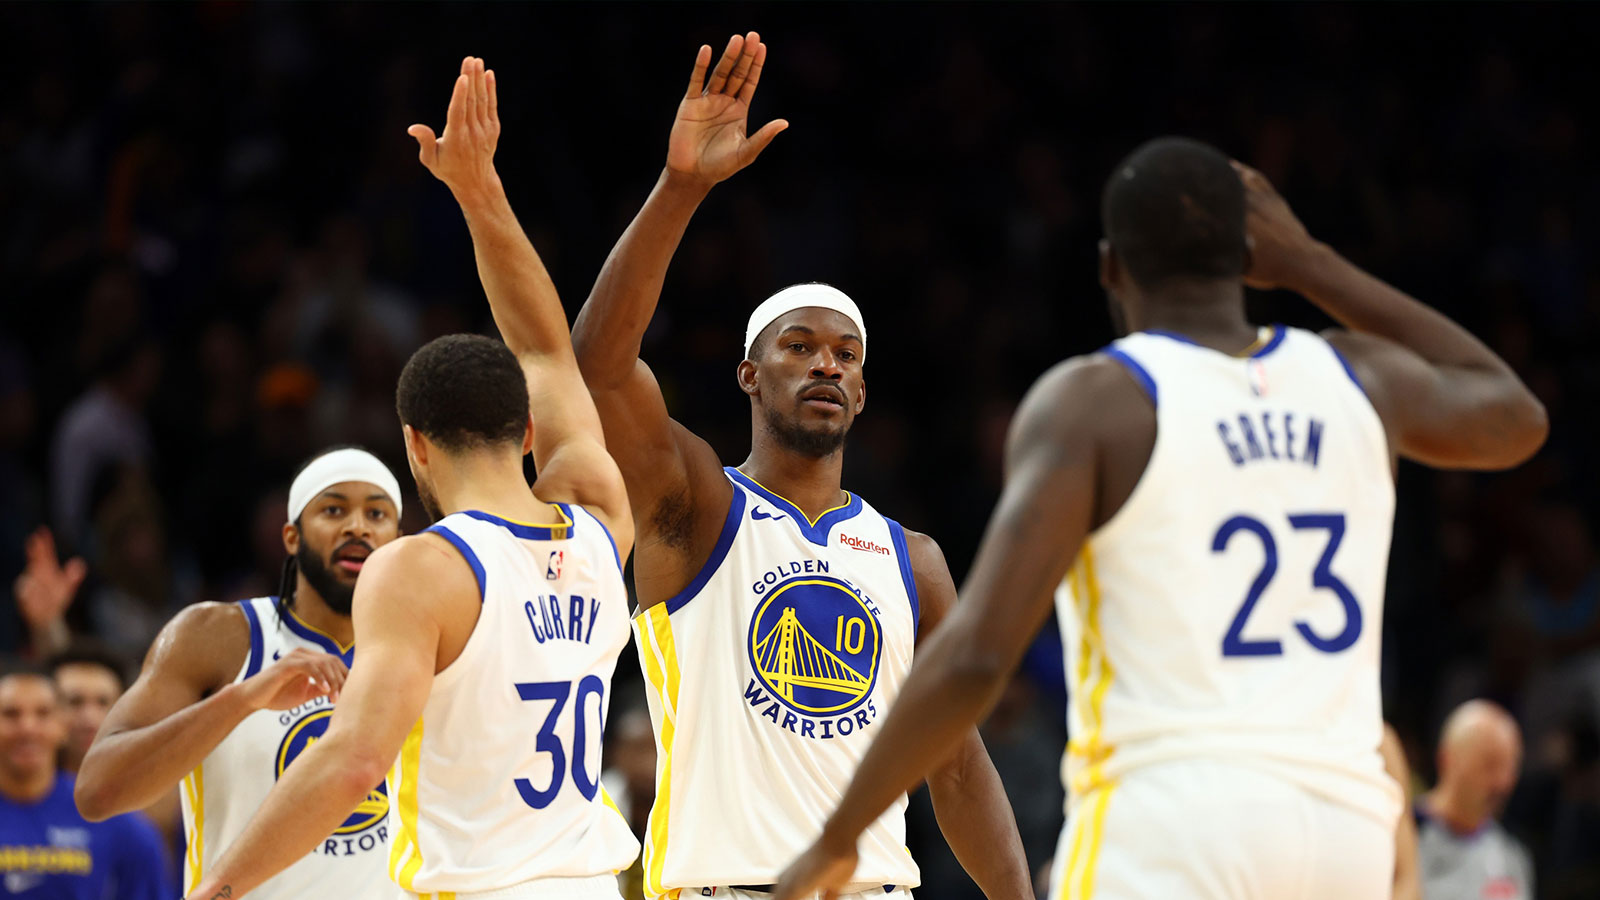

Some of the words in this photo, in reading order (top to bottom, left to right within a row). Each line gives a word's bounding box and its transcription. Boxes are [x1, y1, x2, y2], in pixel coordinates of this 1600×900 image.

[1216, 411, 1324, 468] GREEN
[839, 533, 890, 556] Rakuten
[752, 559, 829, 595] GOLDEN
[843, 578, 882, 616] ATE
[1210, 513, 1363, 658] 23
[524, 594, 601, 645] CURRY
[835, 614, 866, 655] 10
[279, 695, 332, 726] GOLD
[744, 677, 877, 740] WARRIORS
[513, 674, 605, 810] 30
[312, 815, 389, 857] RIOR
